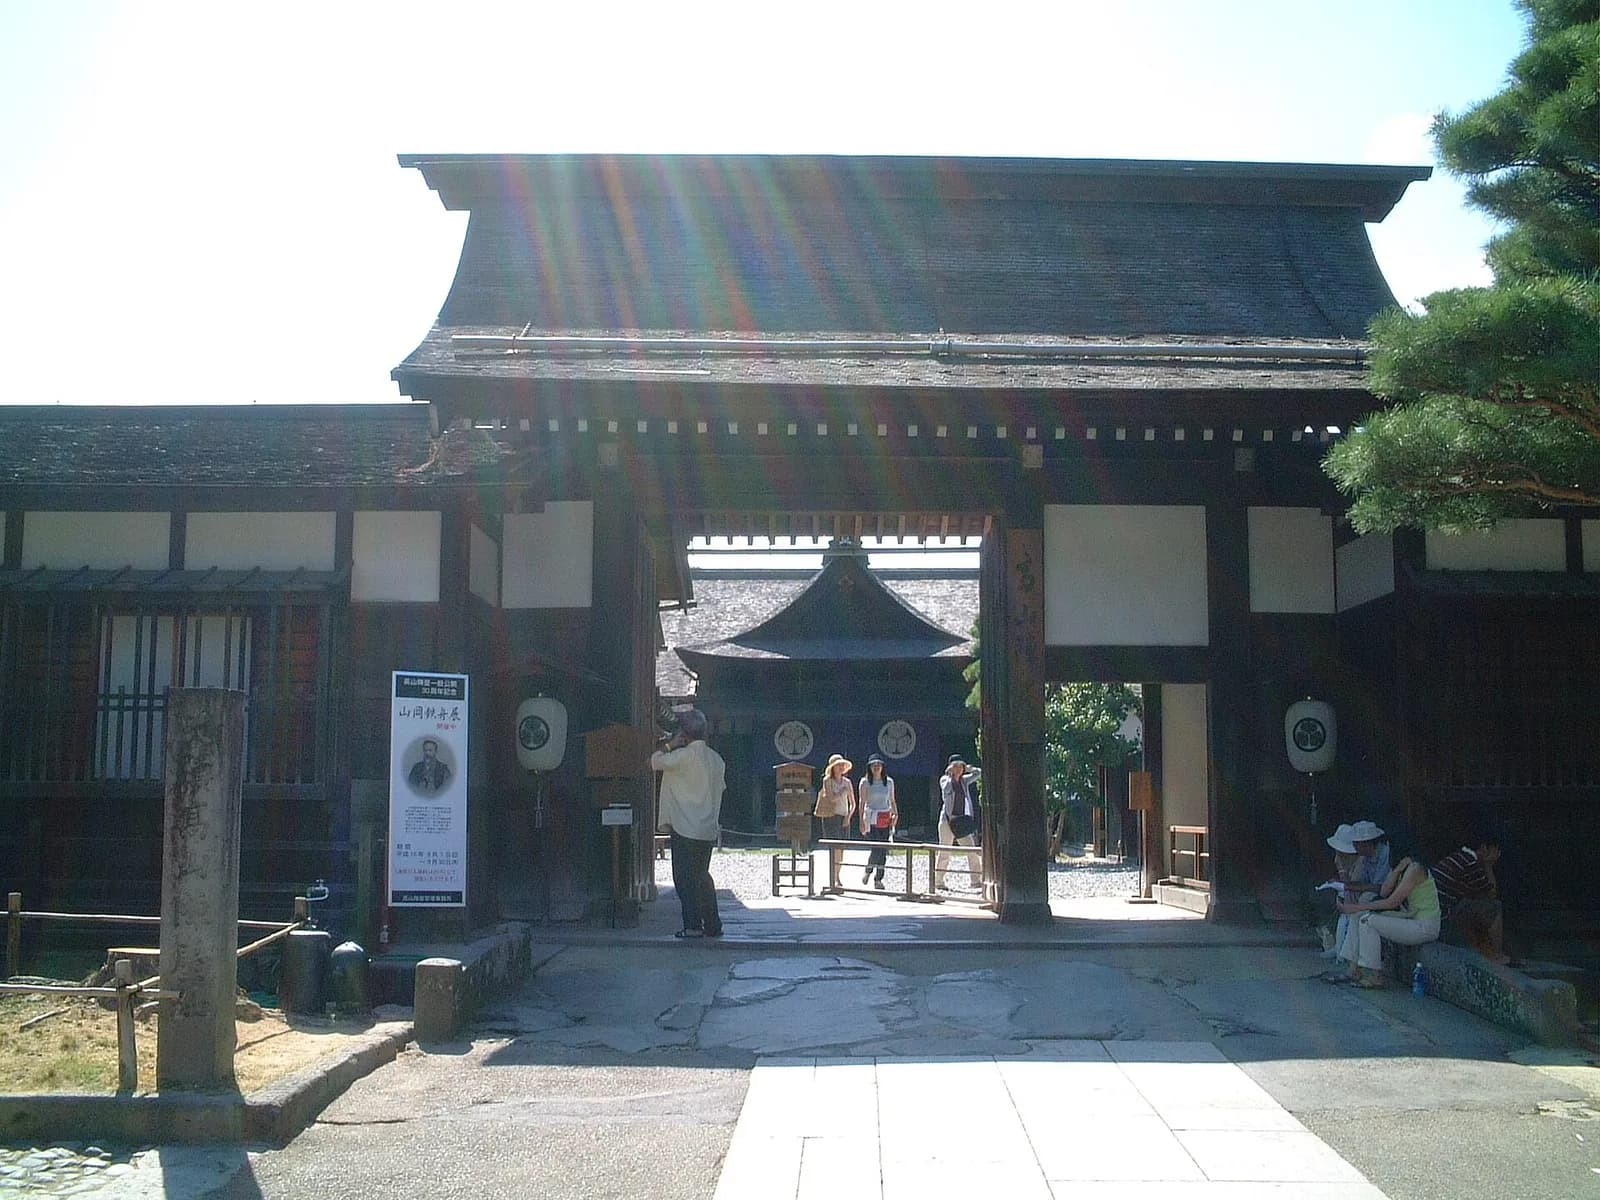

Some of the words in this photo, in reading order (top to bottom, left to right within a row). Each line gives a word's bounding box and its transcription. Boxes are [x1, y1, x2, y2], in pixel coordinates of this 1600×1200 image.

[399, 705, 461, 721] 山岡鉄舟展
